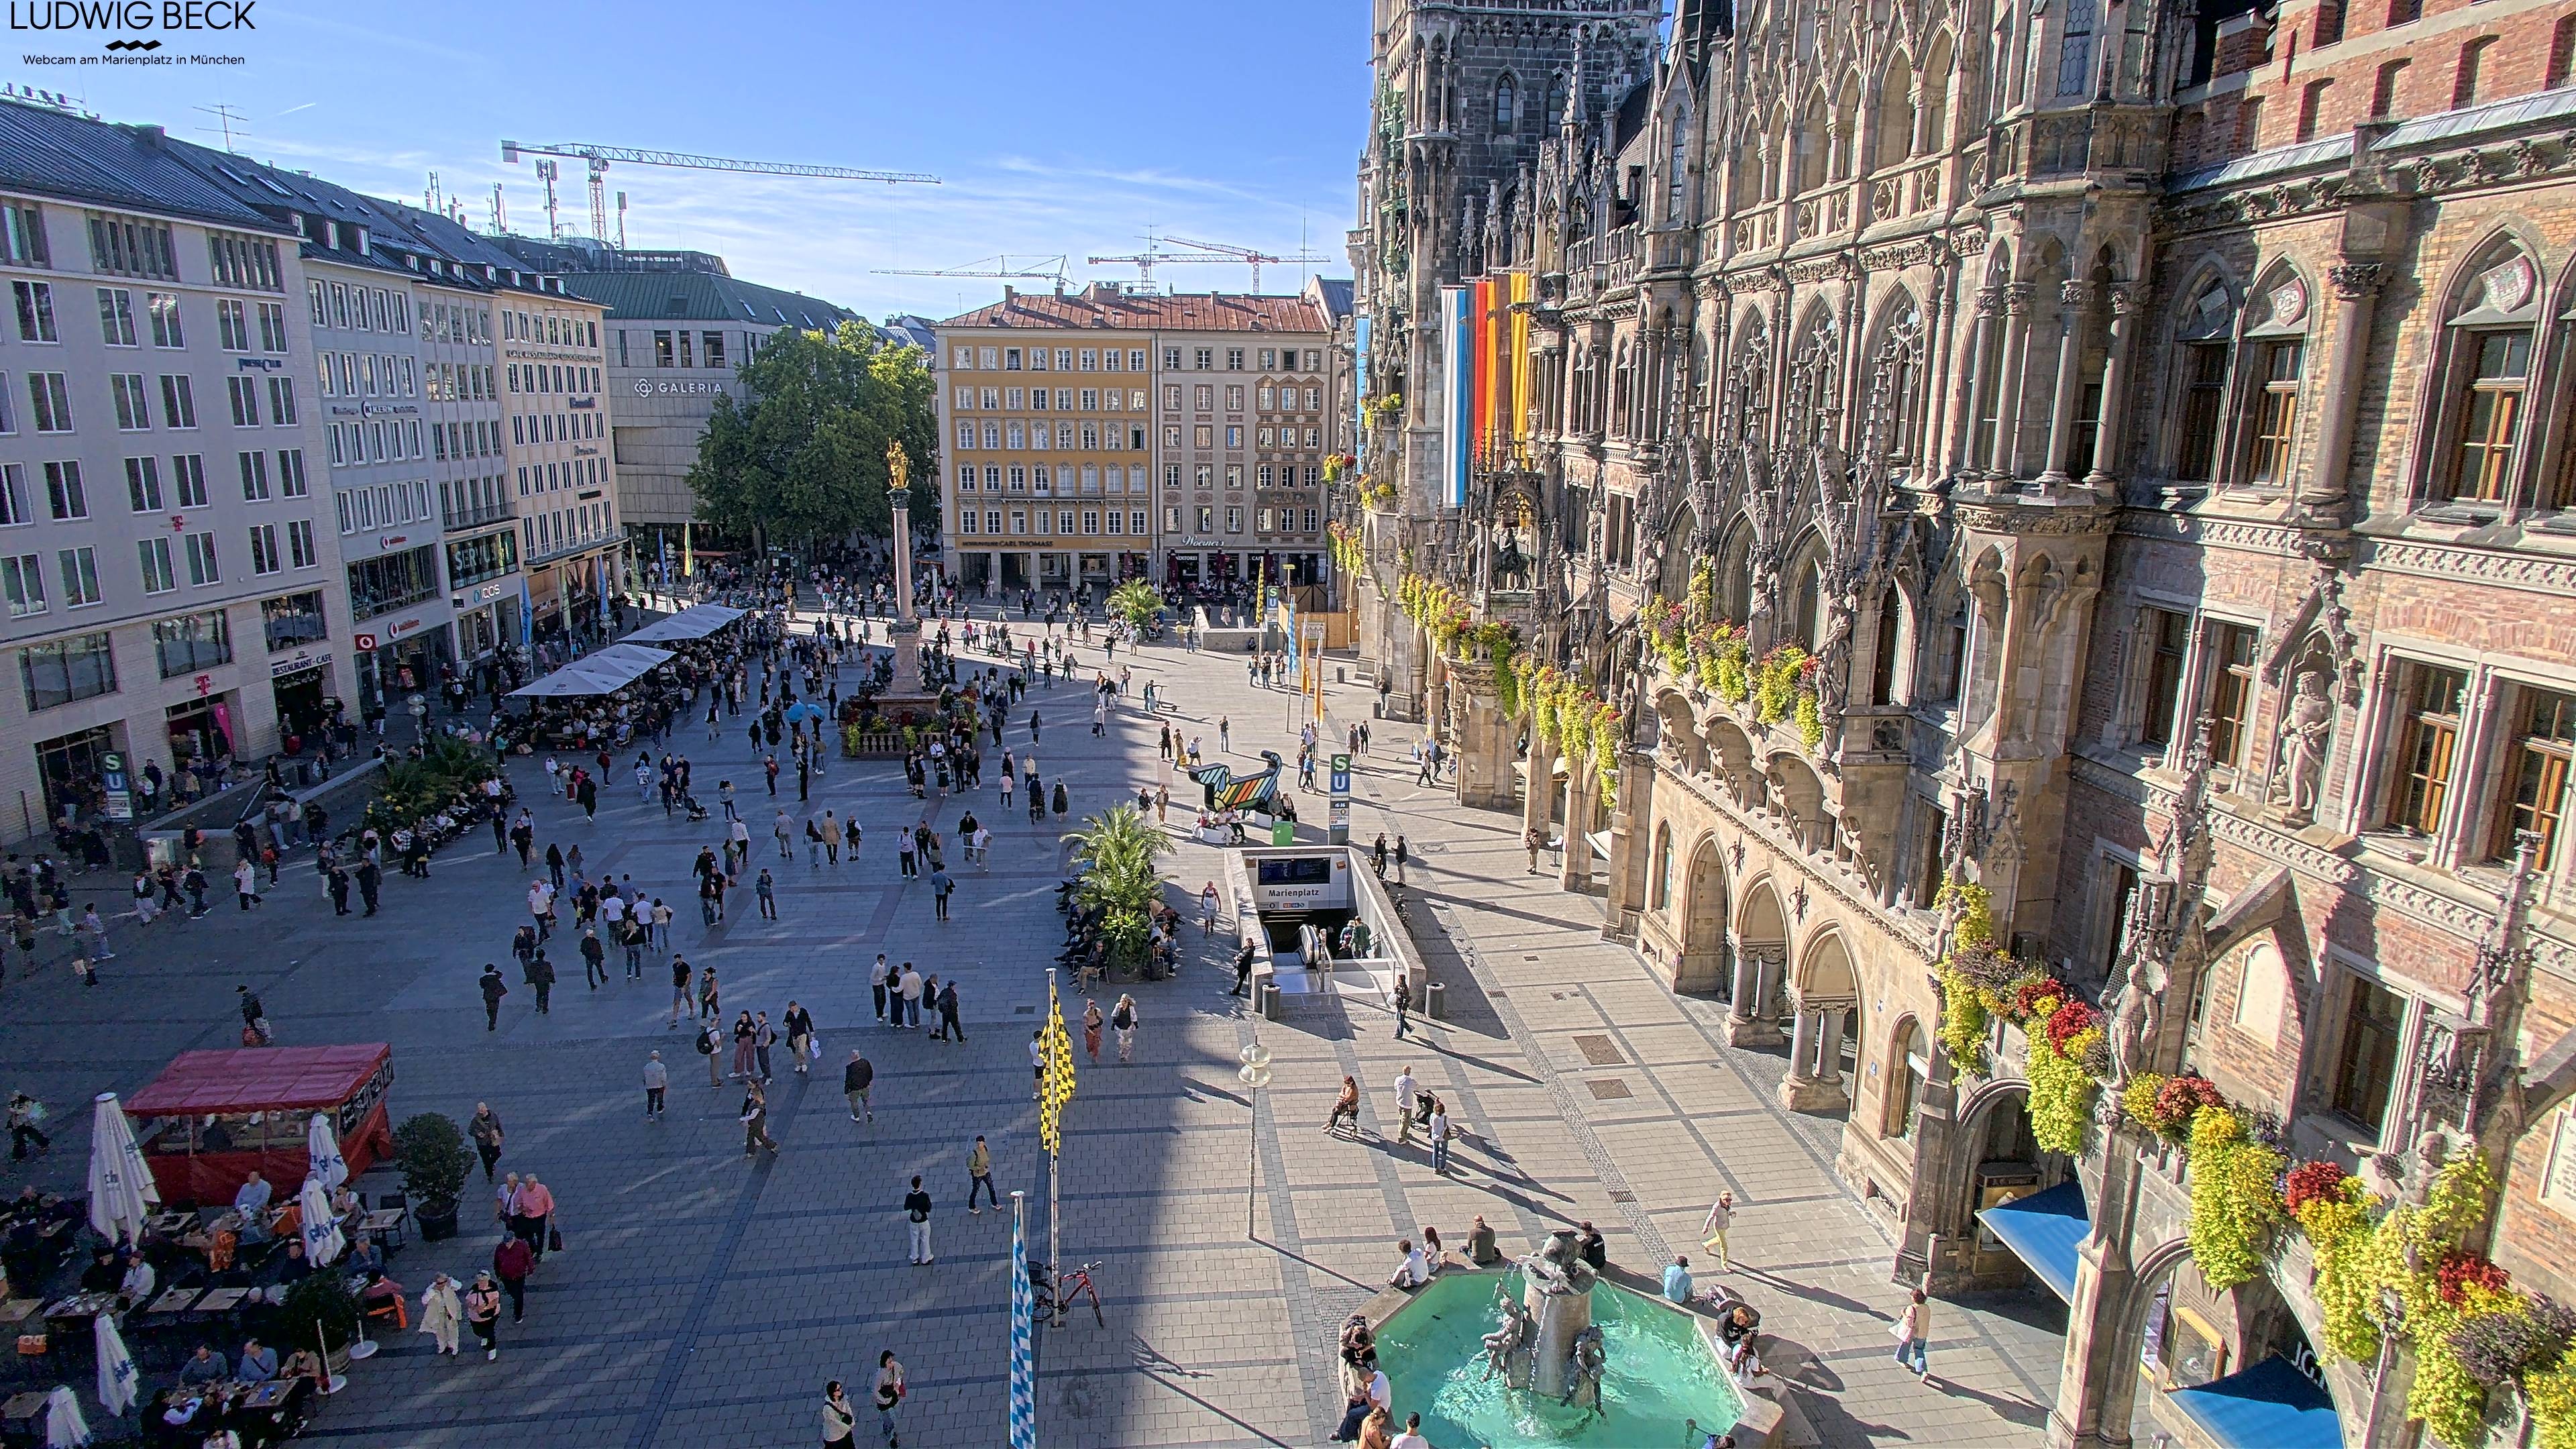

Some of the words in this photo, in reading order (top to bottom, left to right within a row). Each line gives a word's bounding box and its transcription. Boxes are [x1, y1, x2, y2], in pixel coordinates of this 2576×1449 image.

[659, 383, 722, 393] GALERIA
[482, 584, 500, 599] IQOS
[1269, 588, 1277, 597] S
[1269, 599, 1277, 607] U
[106, 755, 120, 770] S
[1334, 757, 1347, 771] S
[109, 774, 122, 788] U
[1334, 775, 1346, 790] U
[1269, 889, 1320, 898] Marienplatz
